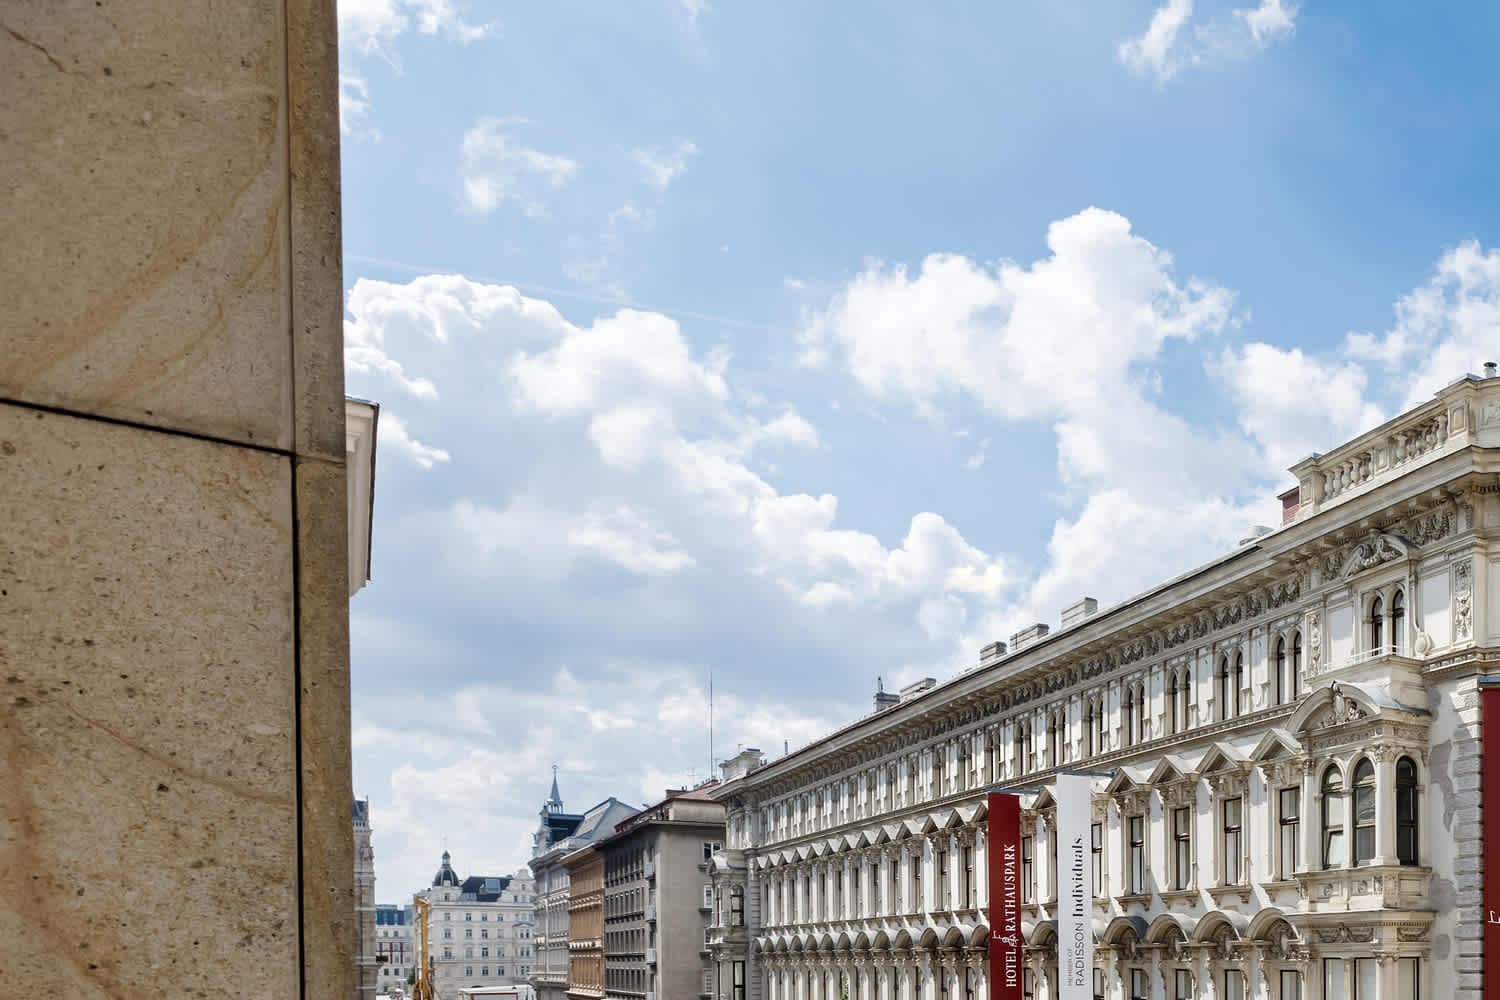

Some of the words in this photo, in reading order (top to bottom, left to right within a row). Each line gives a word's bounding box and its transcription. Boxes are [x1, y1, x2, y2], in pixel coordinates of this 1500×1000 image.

[1004, 844, 1016, 931] RATHAUSPARK
[1005, 948, 1017, 987] HOTEL
[1074, 922, 1085, 986] RADISSON
